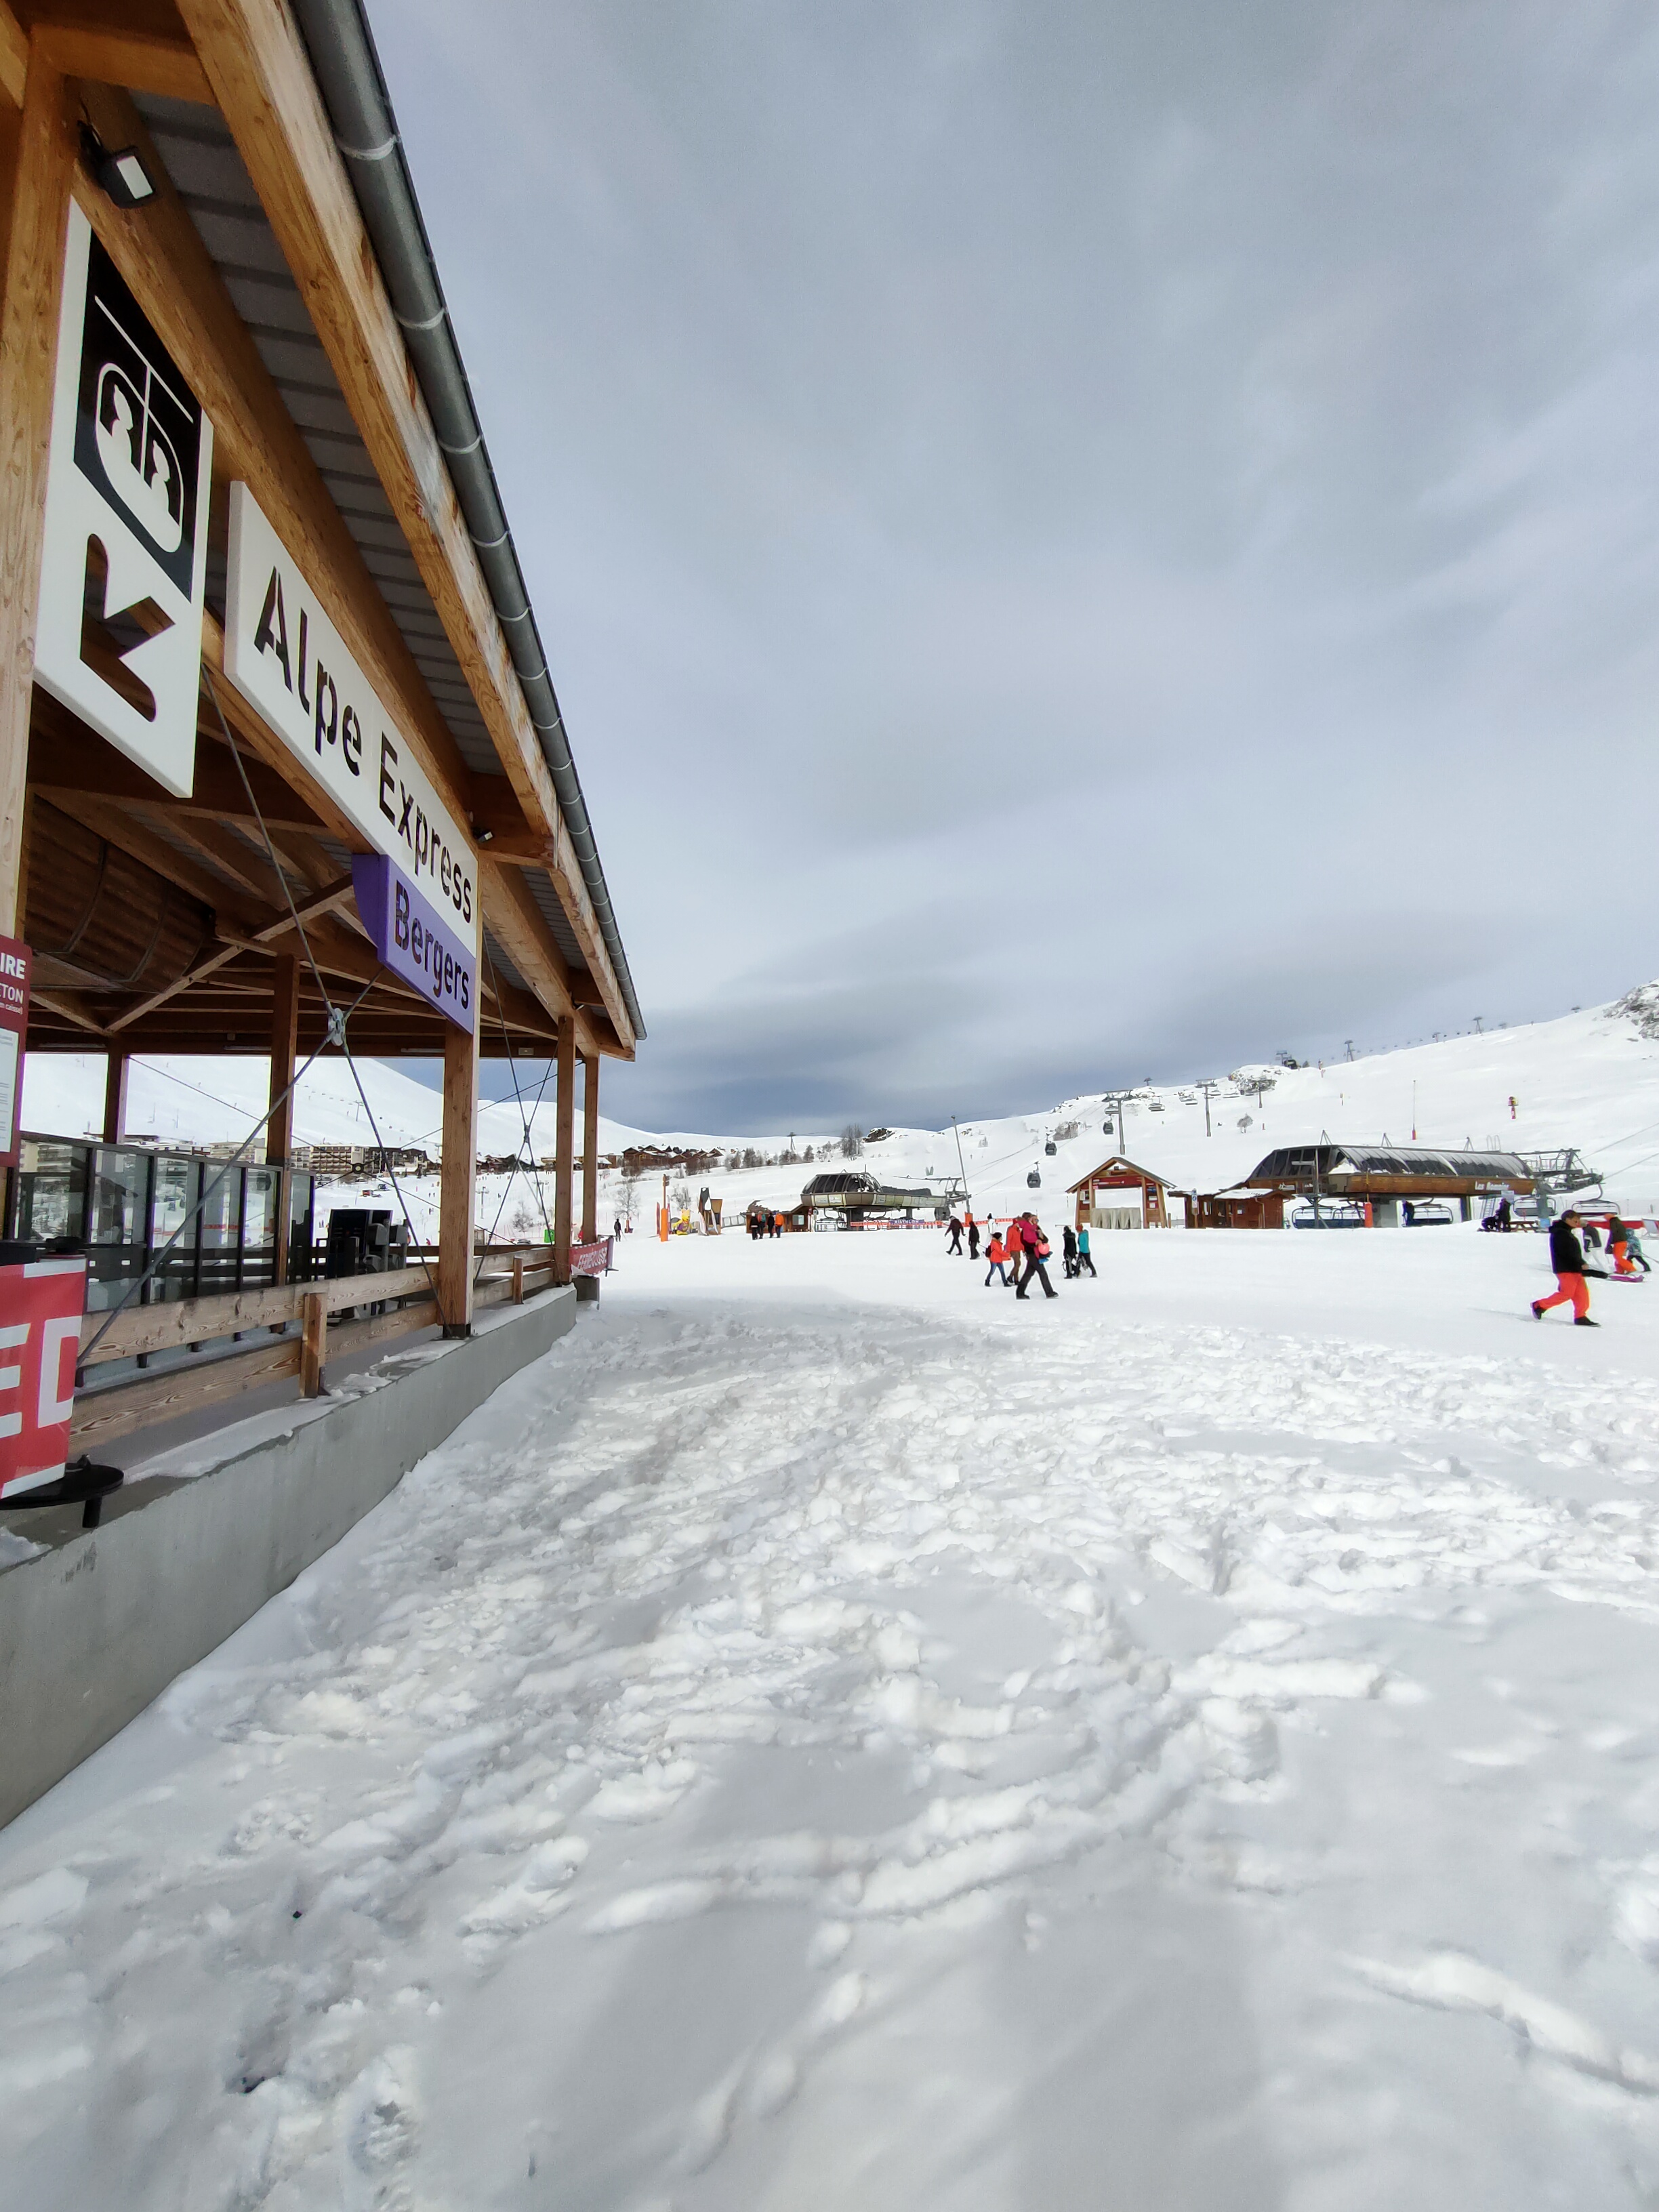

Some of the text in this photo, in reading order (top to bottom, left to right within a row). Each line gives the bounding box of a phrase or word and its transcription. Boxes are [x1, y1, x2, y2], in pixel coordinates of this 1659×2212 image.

[254, 565, 472, 924] Alpe Express
[0, 982, 24, 1004] TON
[395, 879, 469, 1010] Bergers
